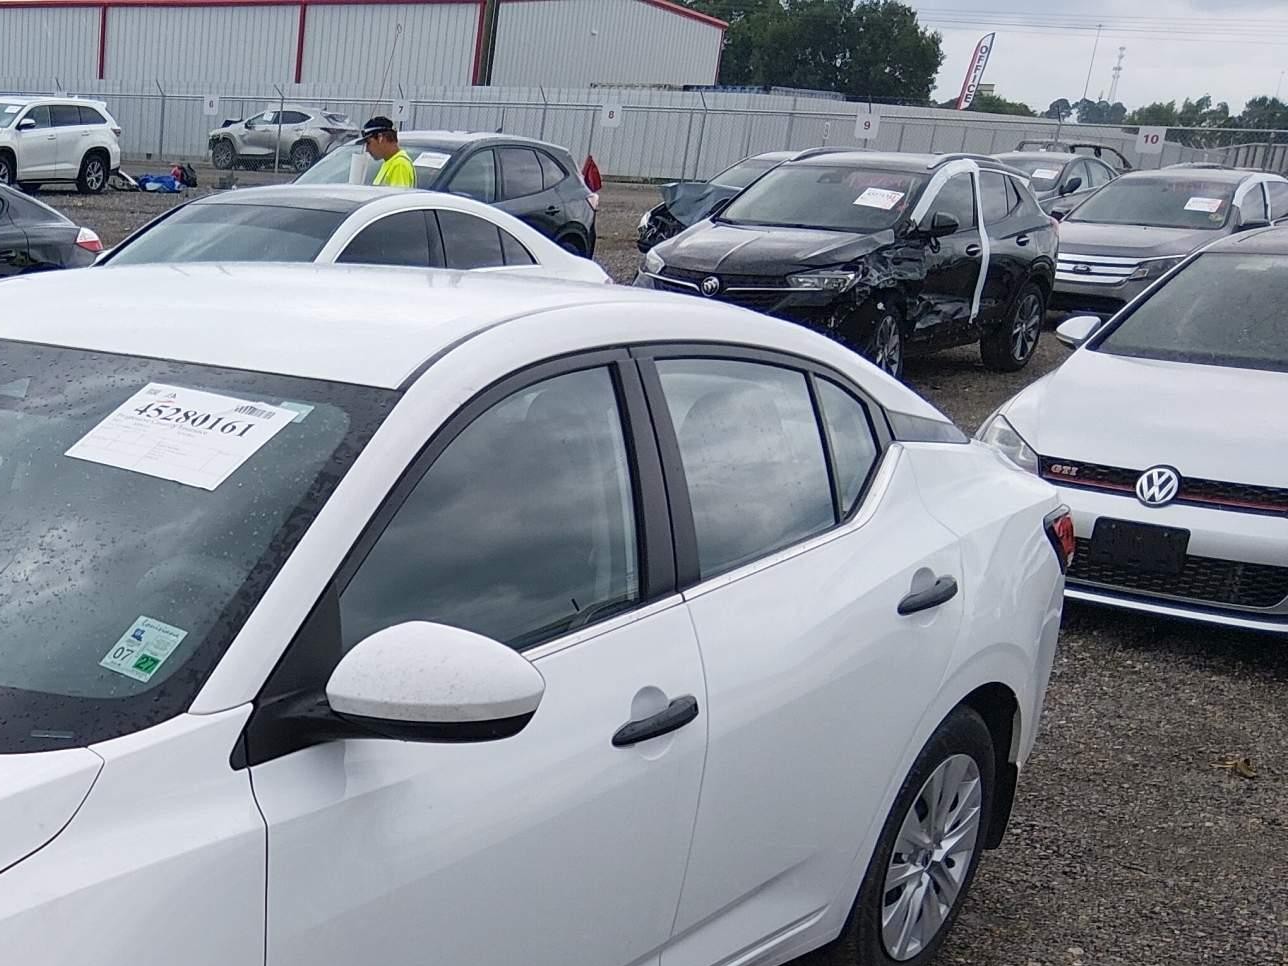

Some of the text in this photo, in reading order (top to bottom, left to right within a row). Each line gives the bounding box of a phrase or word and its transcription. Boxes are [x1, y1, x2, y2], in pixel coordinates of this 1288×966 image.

[964, 45, 989, 103] OFFICE
[398, 105, 404, 114] 7
[608, 110, 615, 119] 8
[864, 121, 871, 130] 9
[1143, 134, 1159, 145] 10
[134, 402, 255, 437] 45280161
[1050, 464, 1078, 476] GTI
[113, 646, 134, 661] 07
[135, 655, 158, 671] 27
